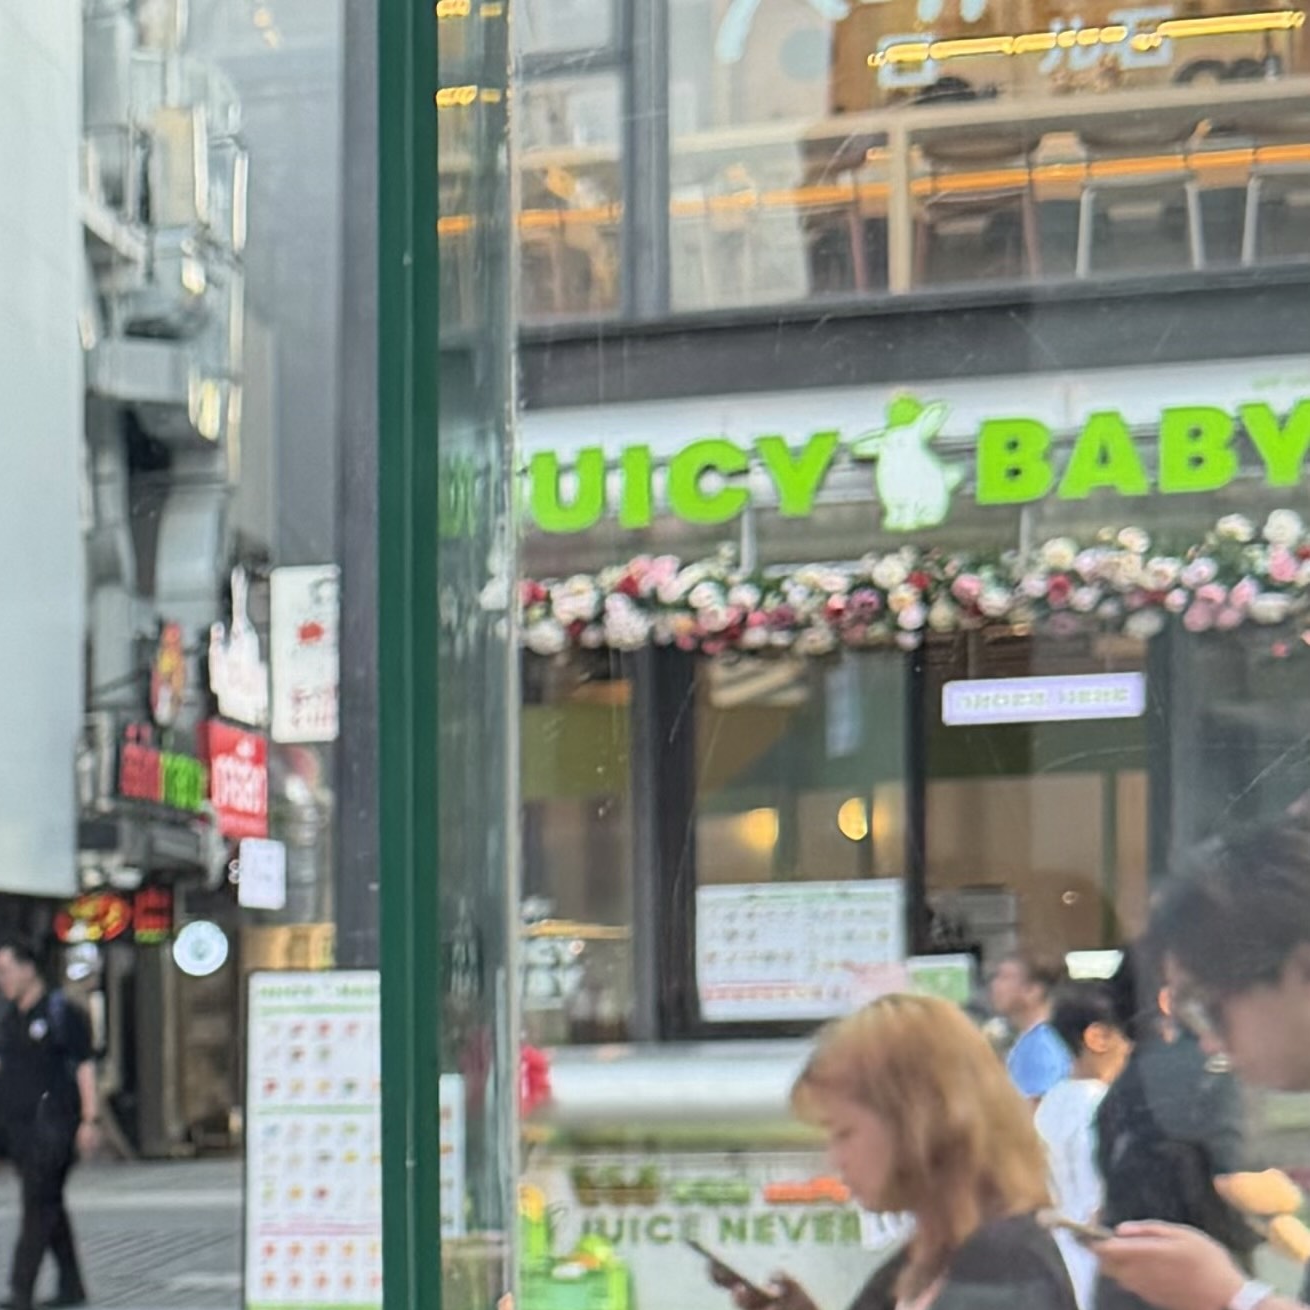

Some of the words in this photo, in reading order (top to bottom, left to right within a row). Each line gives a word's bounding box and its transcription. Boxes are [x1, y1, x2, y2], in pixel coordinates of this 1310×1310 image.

[530, 429, 841, 534] UICY
[976, 400, 1310, 506] BABY
[718, 1210, 862, 1246] NEVER
